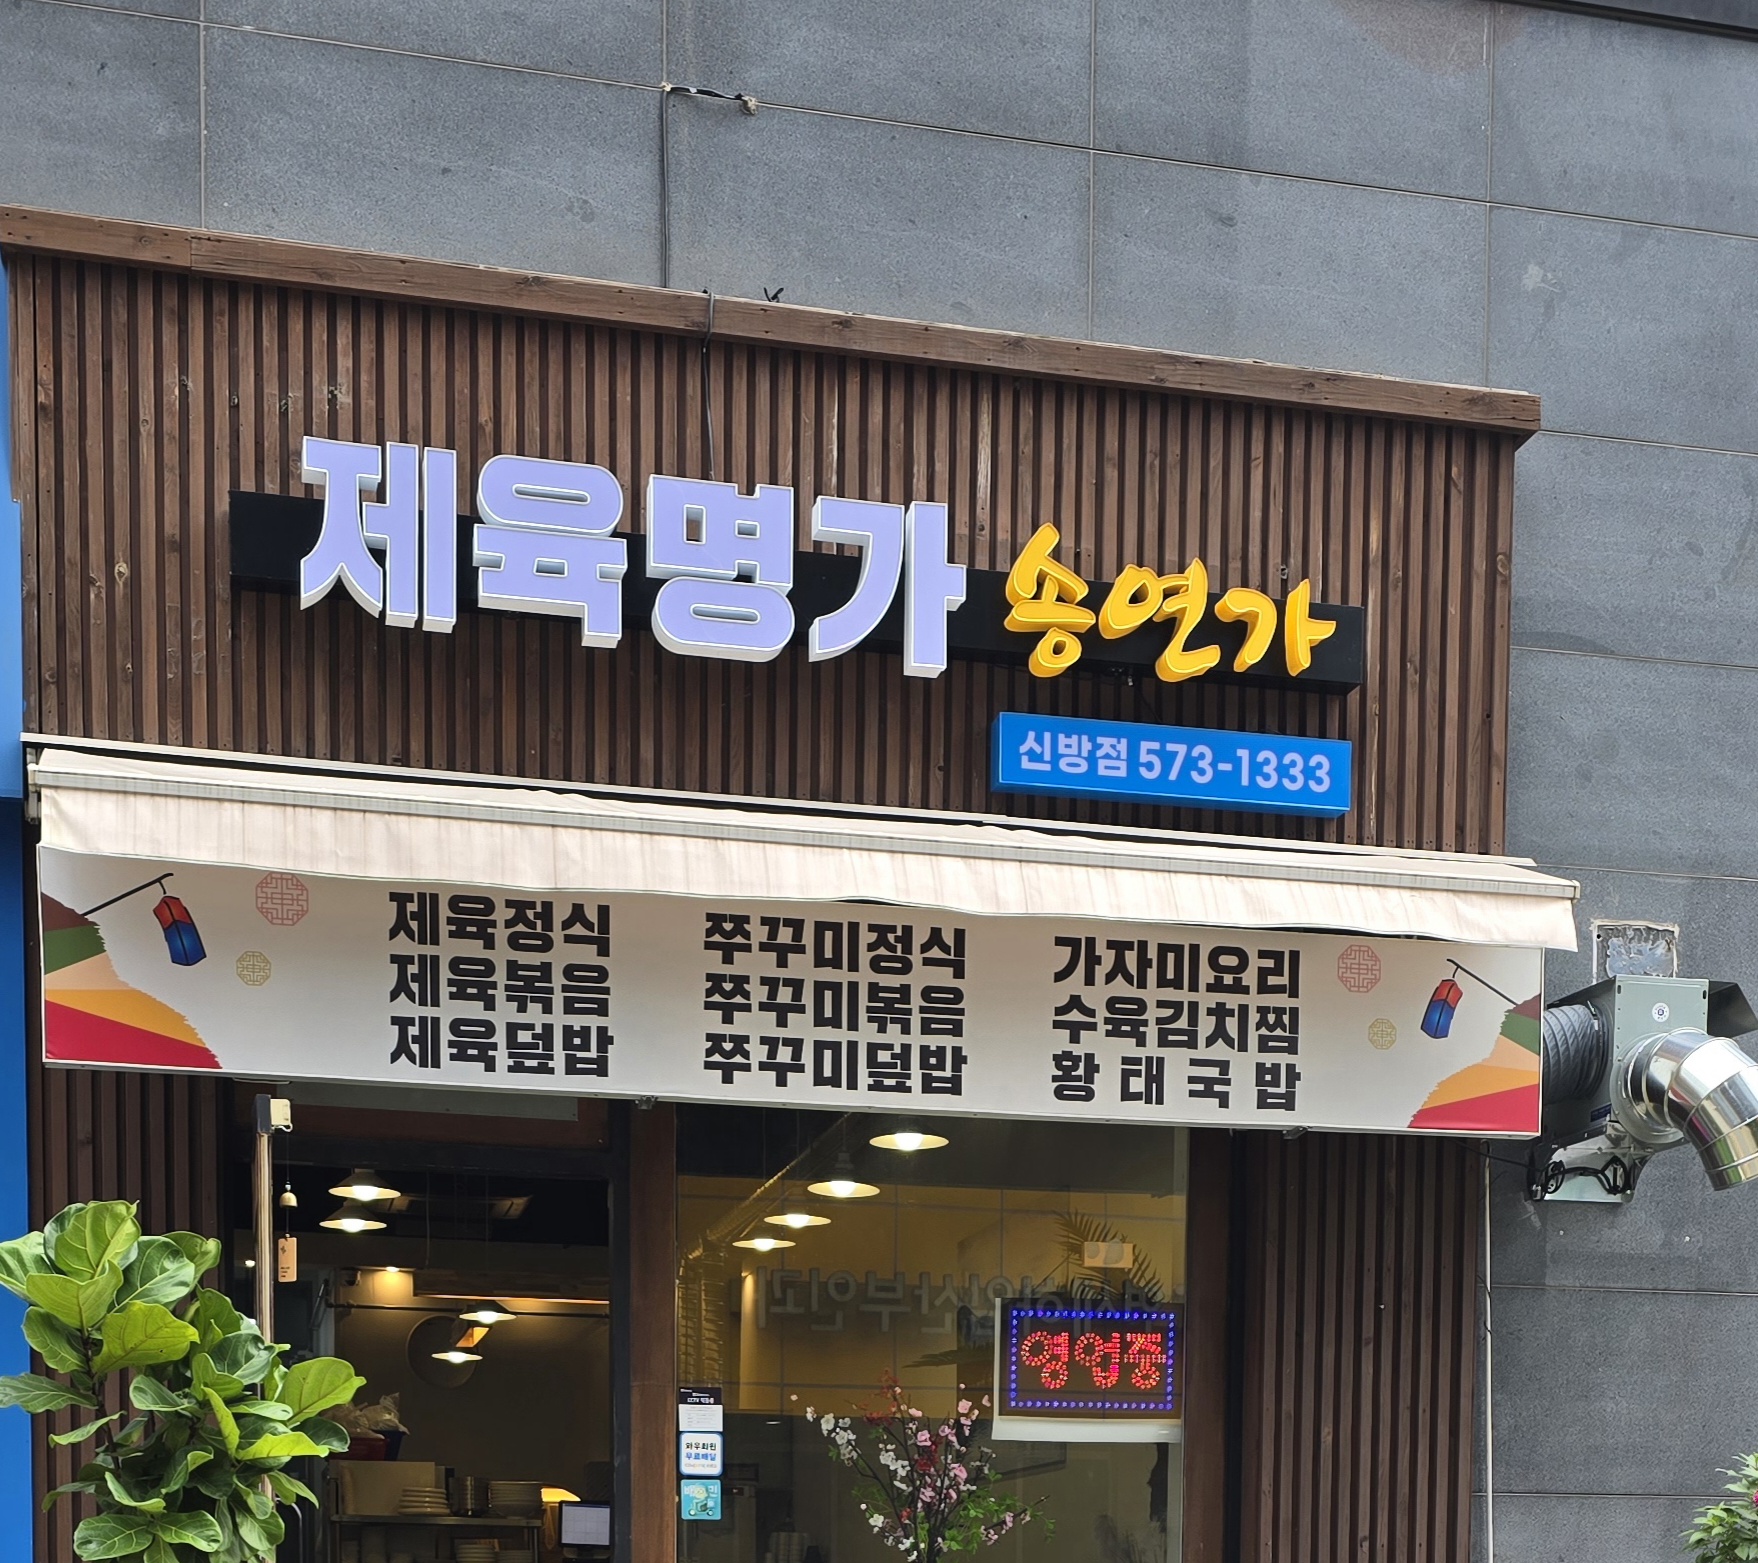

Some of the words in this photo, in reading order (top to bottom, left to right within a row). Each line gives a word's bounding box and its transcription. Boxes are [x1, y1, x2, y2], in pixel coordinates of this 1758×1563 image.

[300, 436, 966, 678] 제육명가
[1004, 522, 1336, 683] 송연가
[1019, 731, 1128, 778] 신방점
[1139, 740, 1331, 794] 573-1333
[388, 891, 611, 958] 제육정식
[703, 912, 967, 980] 쭈꾸미정식
[389, 953, 611, 1018] 제육볶음
[1053, 935, 1301, 999] 가자미요리
[703, 972, 966, 1038] 쭈꾸미볶음
[1052, 994, 1301, 1056] 수육김치찜
[390, 1015, 614, 1078] 제육덮밥
[703, 1032, 968, 1096] 쭈꾸미덮밥
[1020, 1331, 1167, 1390] 영업중
